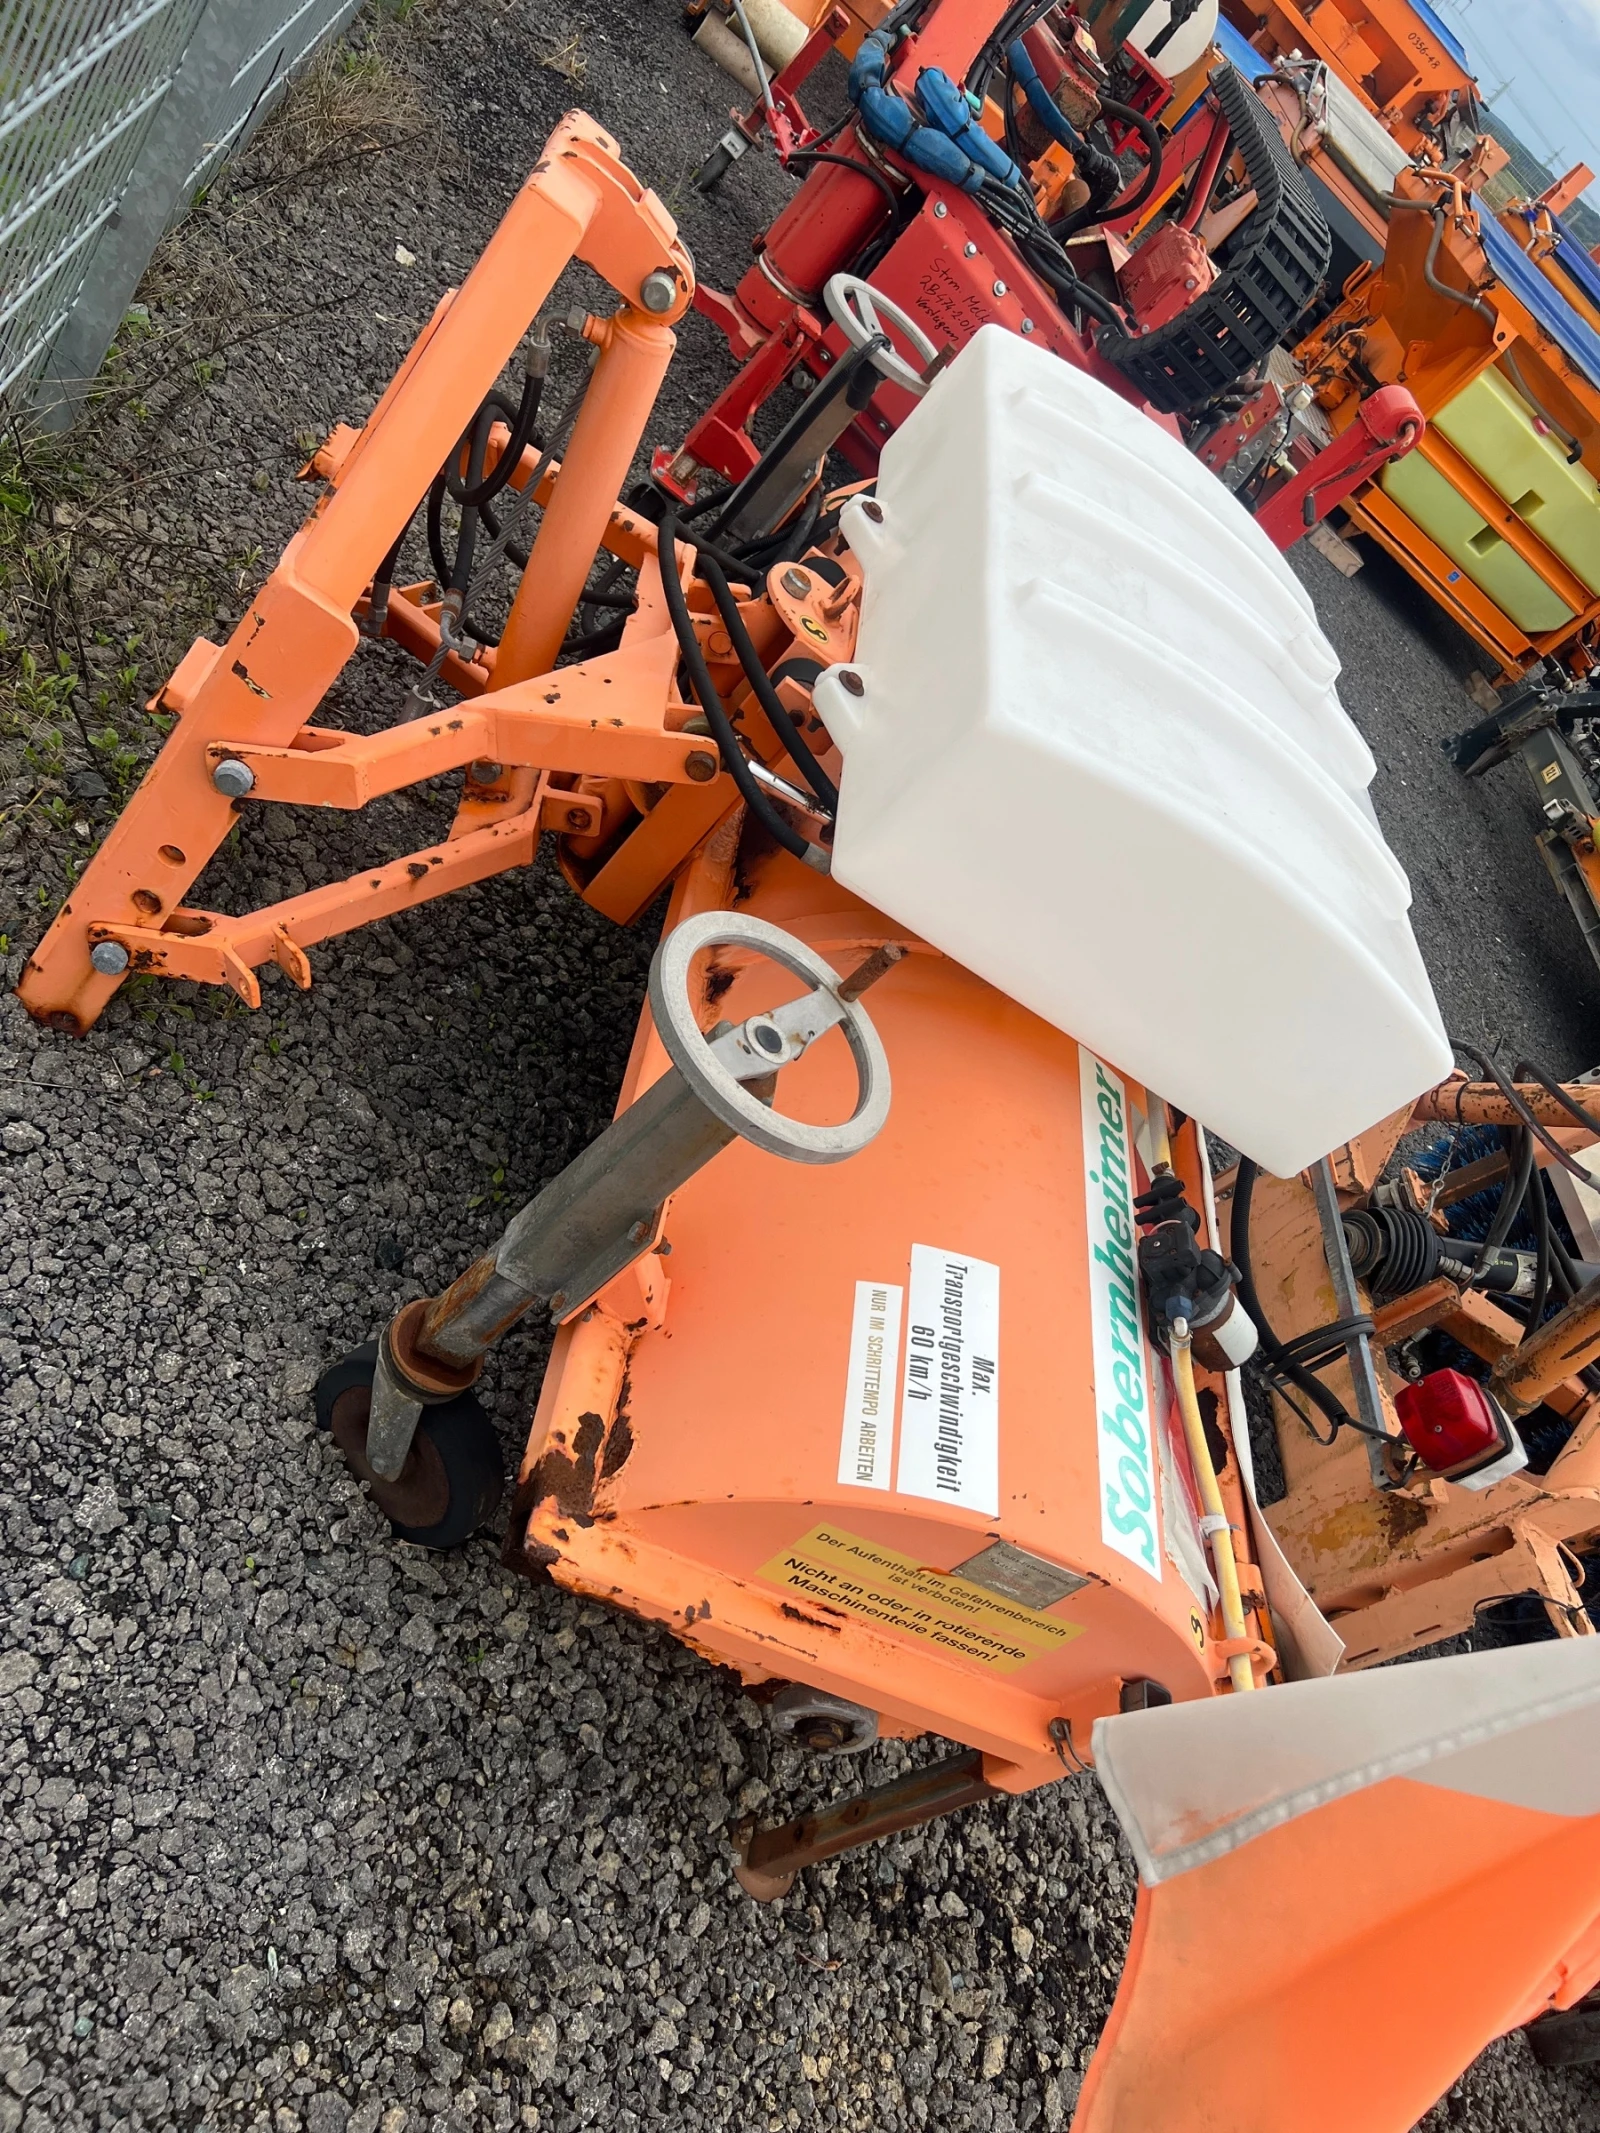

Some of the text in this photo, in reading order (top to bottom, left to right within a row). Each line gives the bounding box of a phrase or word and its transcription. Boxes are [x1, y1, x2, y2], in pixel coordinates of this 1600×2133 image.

[1407, 32, 1441, 69] 0356-48
[907, 1325, 935, 1401] 60 km/h
[1088, 1063, 1156, 1569] Sobernheimer
[856, 1289, 888, 1482] NUR IM SCHRITTEMPO ARBEITEN
[933, 1262, 969, 1493] Transportgeschwindigkeit
[971, 1355, 995, 1397] Max.
[783, 1557, 1027, 1661] Nicht an oder in rotierende
[787, 1574, 929, 1634] Maschinenteile
[930, 1628, 999, 1662] fassen!
[815, 1532, 846, 1549] Der
[846, 1545, 926, 1579] Aufenthalt
[925, 1573, 947, 1590] im
[948, 1585, 1068, 1638] Gefahrenbereich
[887, 1573, 906, 1587] ist
[908, 1581, 979, 1614] verboten!
